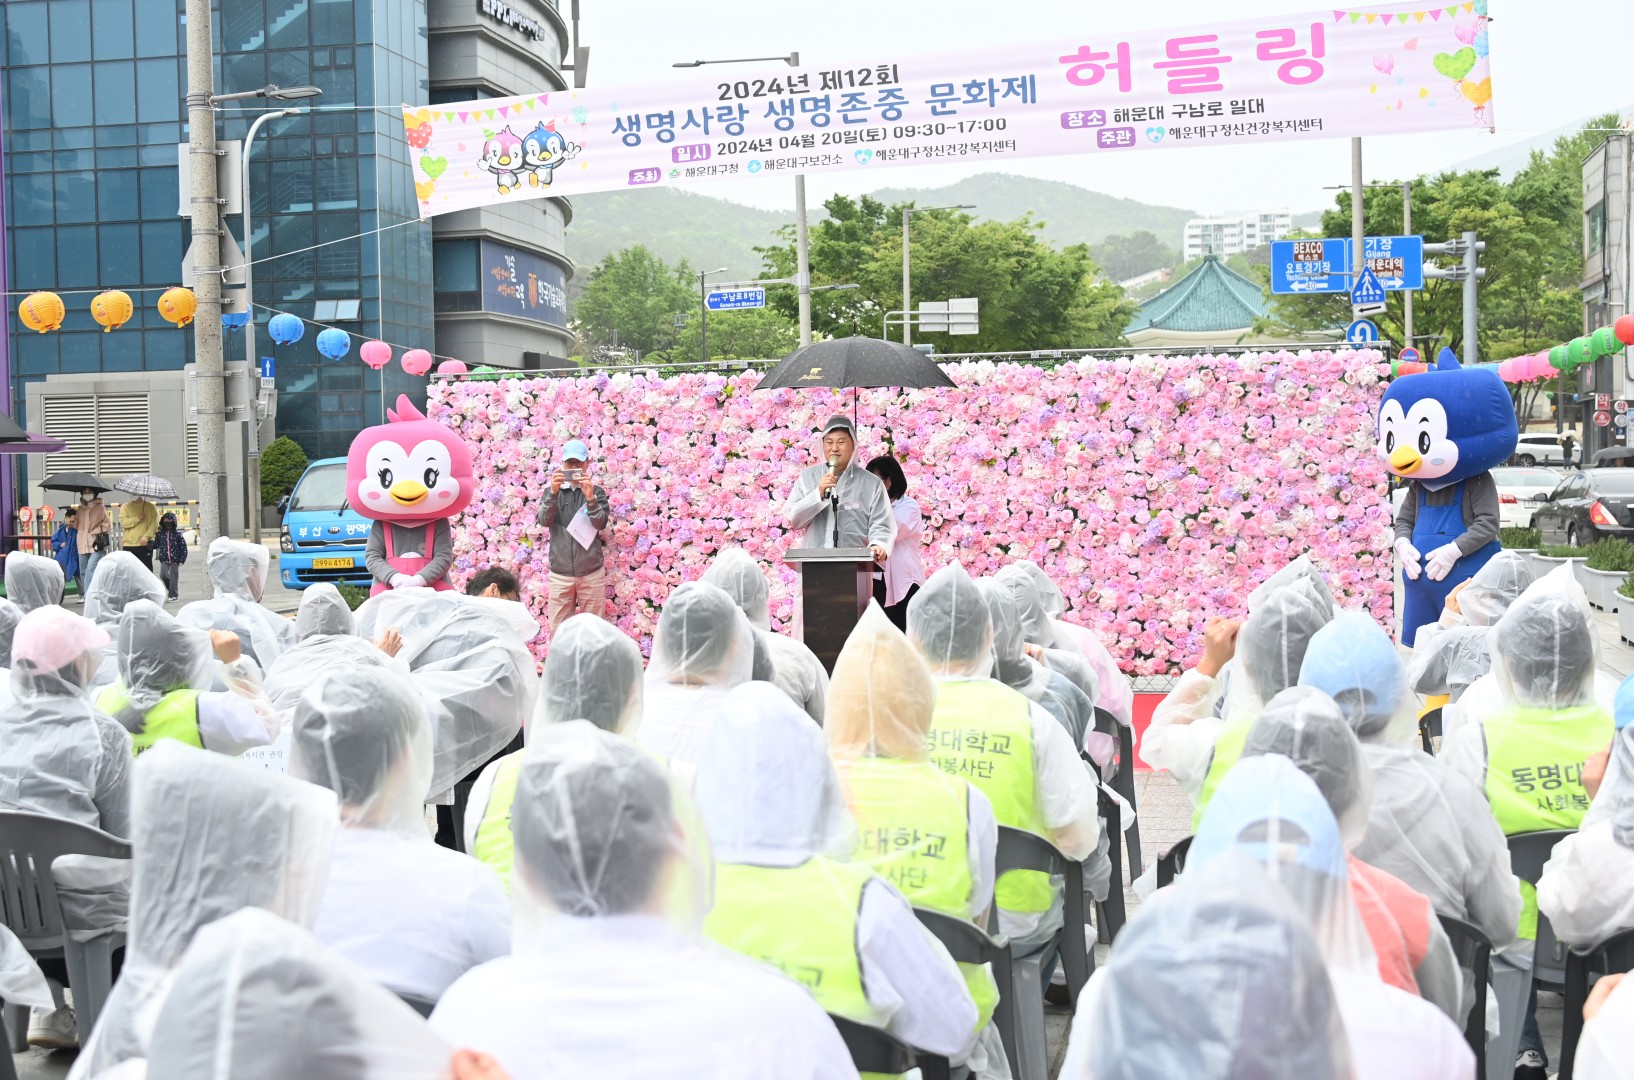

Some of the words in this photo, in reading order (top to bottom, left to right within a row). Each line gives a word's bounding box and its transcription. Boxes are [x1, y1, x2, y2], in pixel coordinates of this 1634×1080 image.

[1058, 22, 1326, 95] 허들링
[717, 73, 811, 101] 2024년
[819, 63, 899, 92] 제12회
[611, 102, 750, 147] 생명사랑
[763, 87, 910, 132] 생명존중
[924, 74, 1037, 117] 문화제
[1067, 111, 1104, 127] 장소
[1113, 105, 1165, 124] 해운대
[1171, 101, 1224, 119] 구남로
[1229, 98, 1265, 115] 일대
[677, 145, 707, 161] 일시
[717, 138, 773, 156] 2024년
[779, 134, 816, 149] 04월
[821, 127, 888, 146] 20일(토)
[893, 117, 1007, 139] 09:30~17:00
[1101, 130, 1132, 146] 주관
[1168, 118, 1323, 140] 해운대구정신건강복지센터
[632, 169, 658, 183] 주최
[685, 163, 739, 178] 해운대구청
[764, 154, 843, 171] 해운대구보건소
[875, 139, 1016, 161] 해운대구정신건강복지센터
[1294, 242, 1322, 254] BEXCO
[1365, 238, 1393, 250] 기장
[1365, 250, 1391, 258] Gijang
[1285, 261, 1331, 274] 요트경기장
[1598, 395, 1609, 407] 약
[299, 526, 322, 538] 부산
